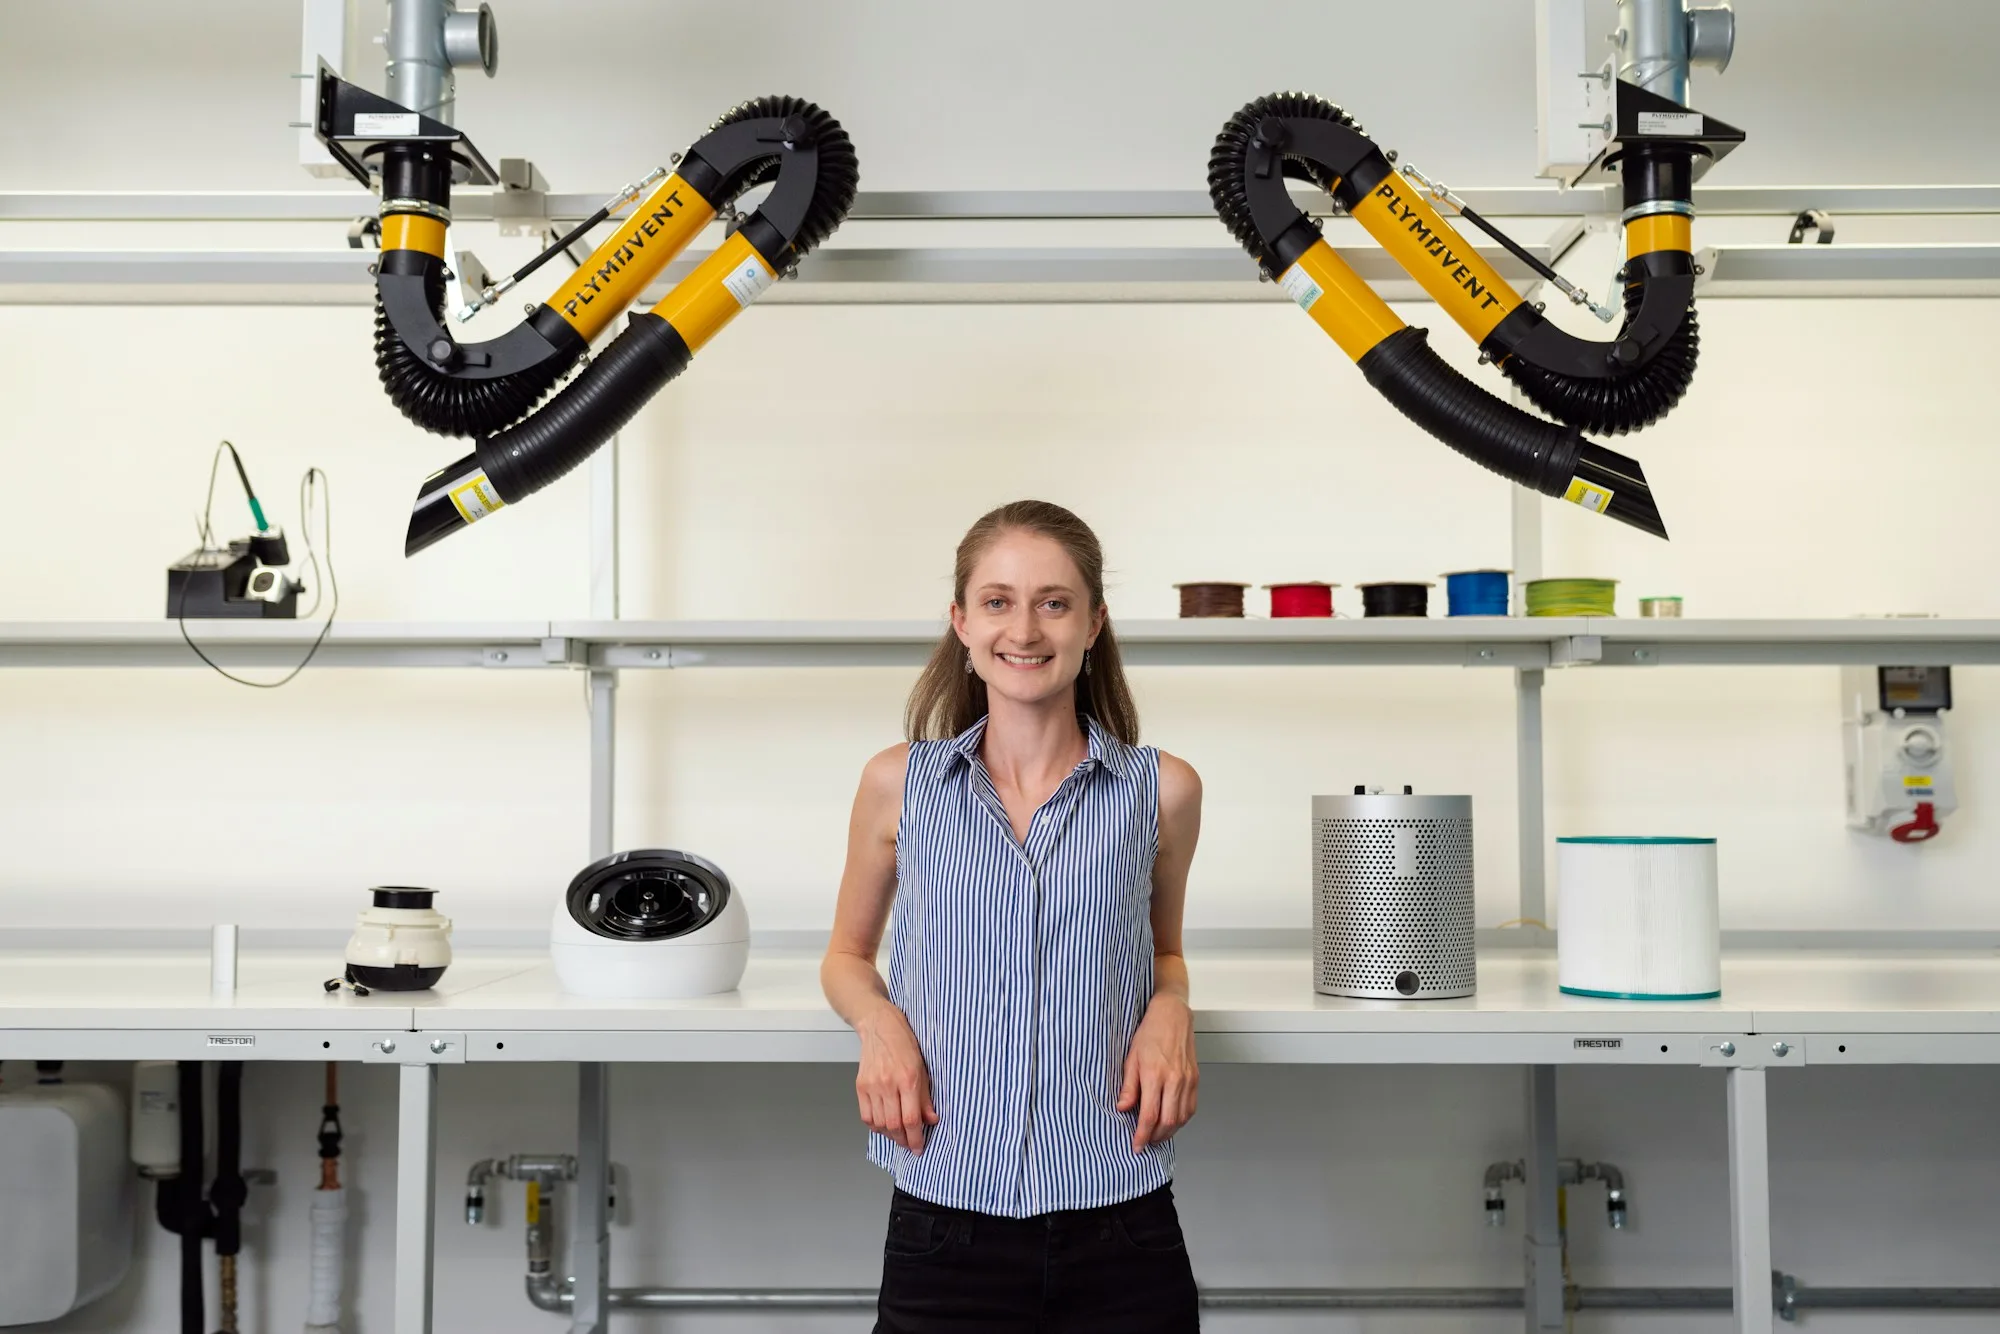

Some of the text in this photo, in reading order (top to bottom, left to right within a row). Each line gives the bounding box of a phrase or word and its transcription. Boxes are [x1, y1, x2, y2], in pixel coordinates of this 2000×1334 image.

[563, 190, 684, 318] PLYMOVENT
[1375, 184, 1499, 310] PLYMOVENT
[209, 1037, 252, 1045] TRESTON
[1576, 1040, 1621, 1048] TRESTON
